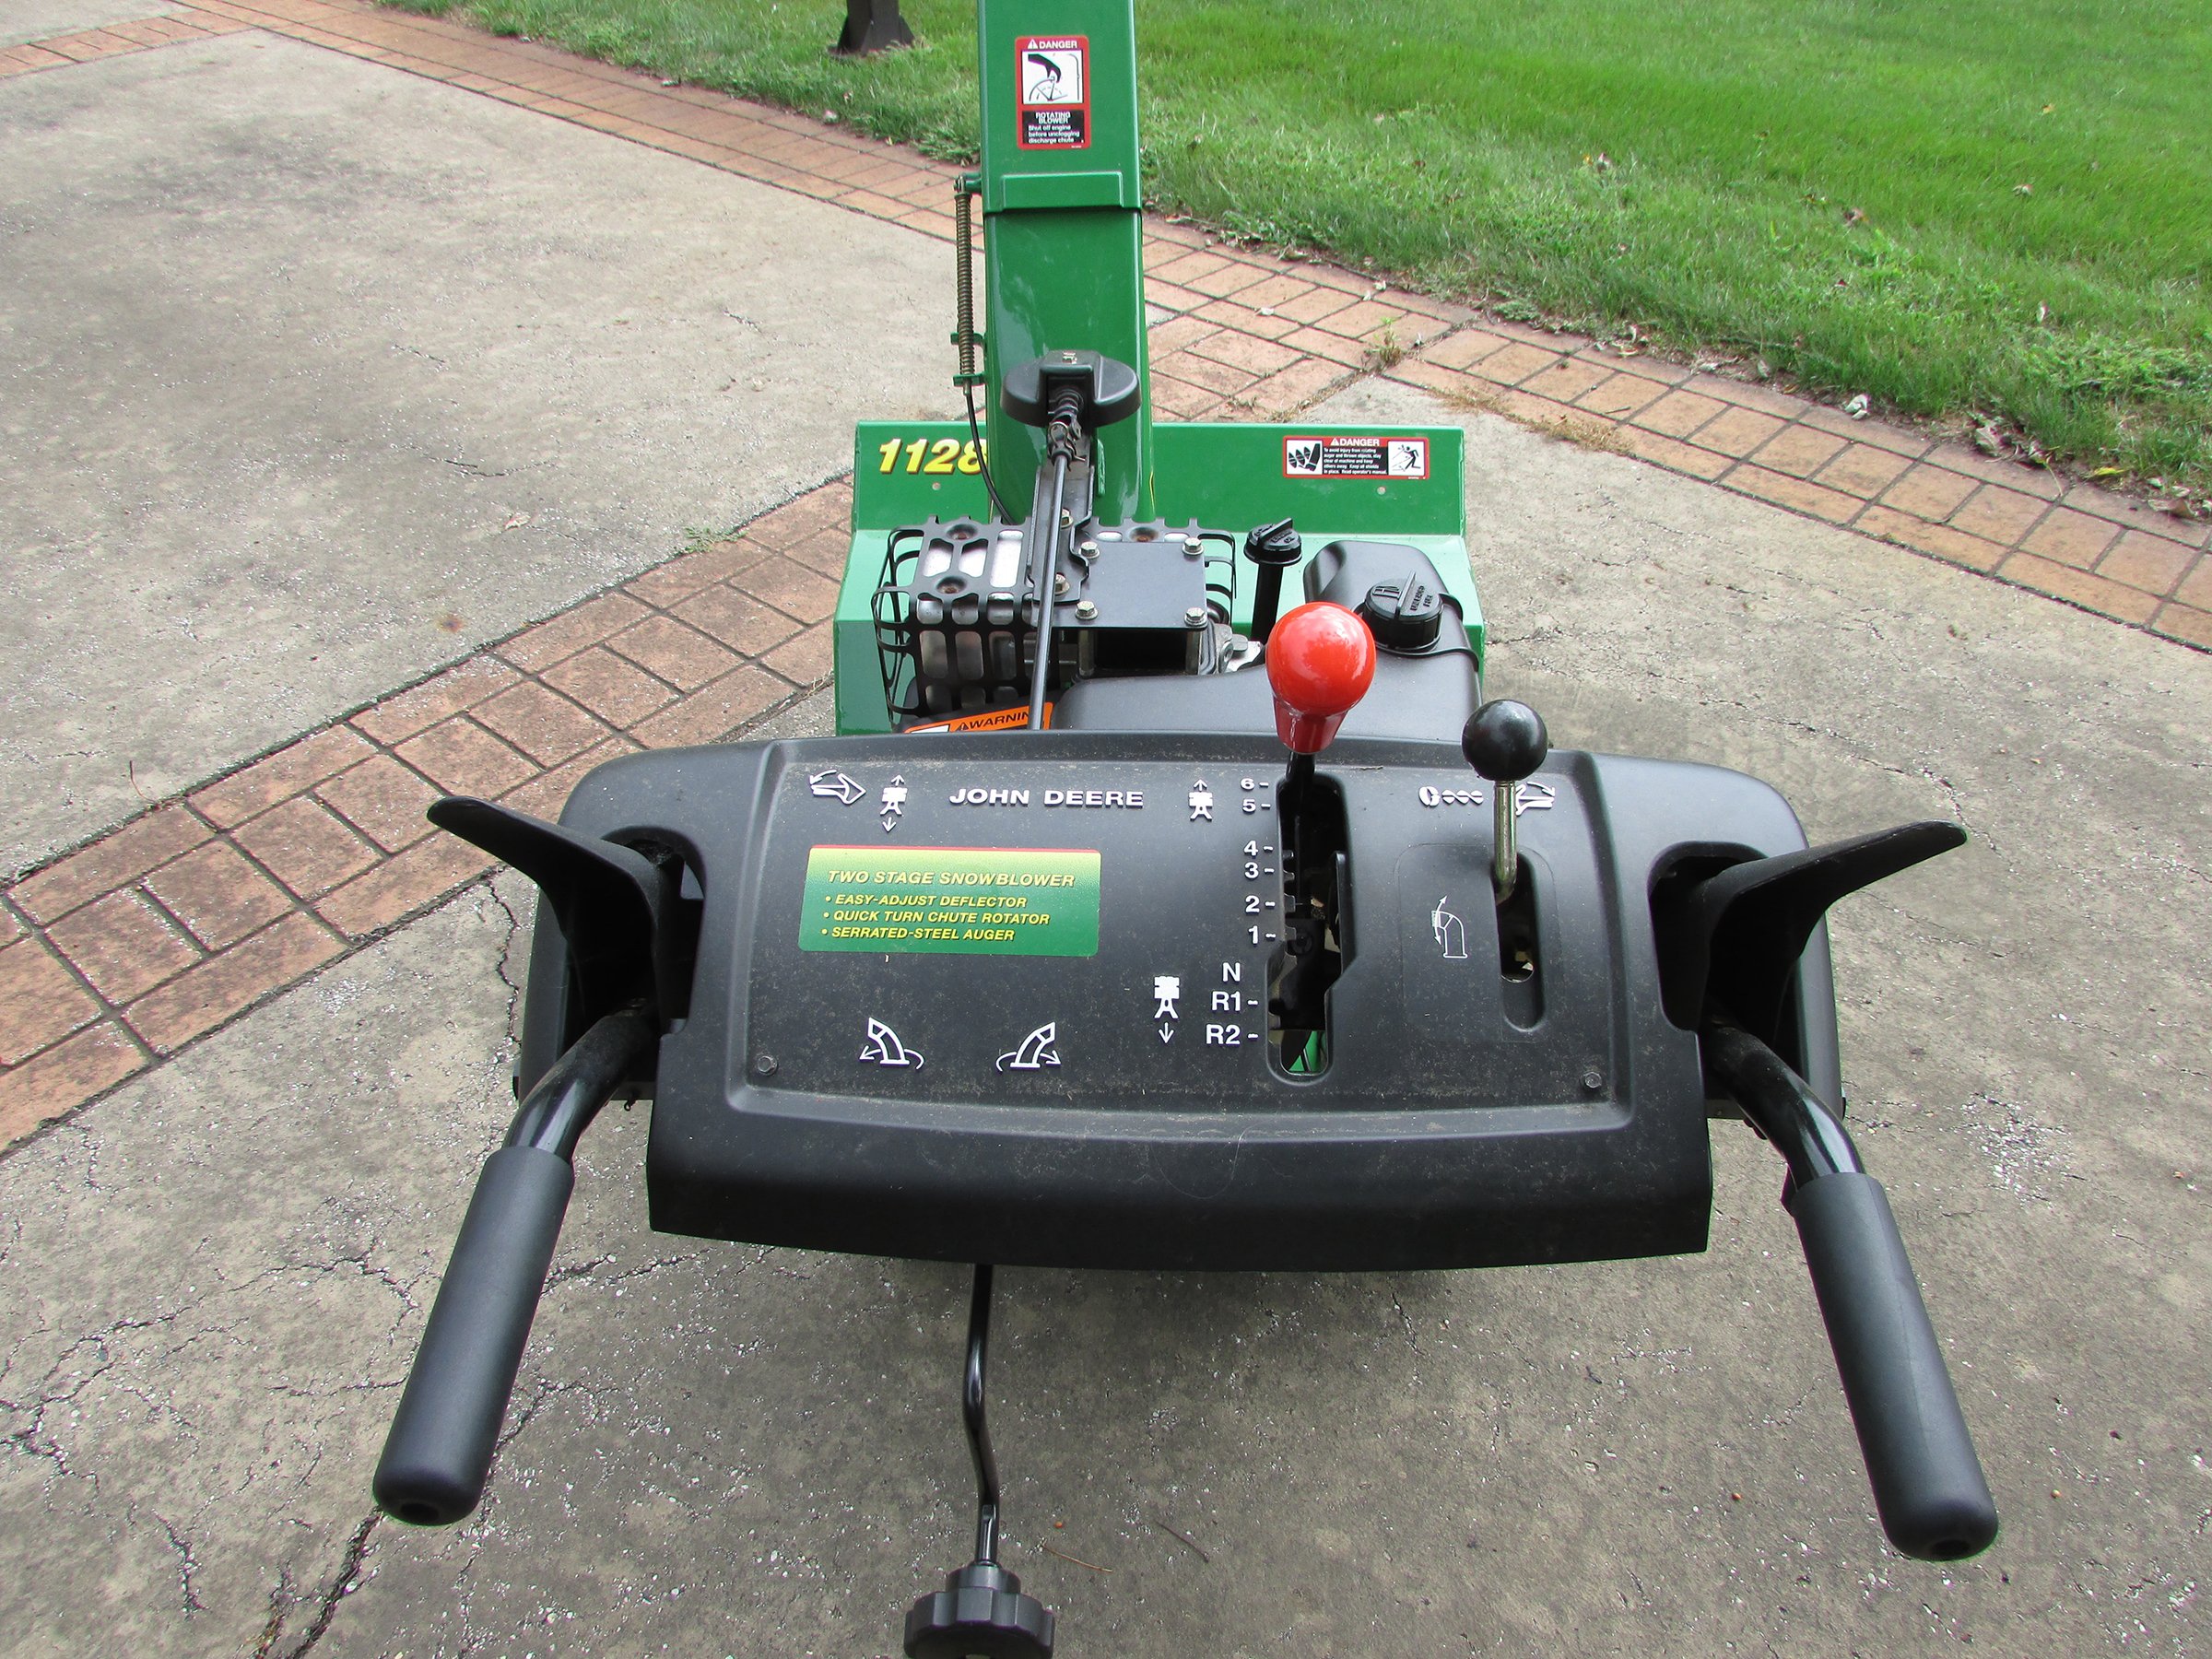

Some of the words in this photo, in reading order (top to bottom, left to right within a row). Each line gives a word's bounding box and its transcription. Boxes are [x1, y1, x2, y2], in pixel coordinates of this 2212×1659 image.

[1039, 41, 1077, 50] DANGER
[1048, 130, 1080, 138] unclogging
[1339, 438, 1380, 447] DANGER
[878, 438, 988, 475] 1128
[970, 711, 1030, 729] WARNIN
[1241, 778, 1255, 791] 6
[949, 788, 1030, 806] JOHN
[1044, 790, 1144, 808] DEERE
[1242, 799, 1257, 814] 5
[1244, 840, 1259, 858] 4
[829, 870, 869, 884] TWO
[874, 871, 935, 885] STAGE
[939, 872, 1076, 888] SNOWBLOWER
[1244, 862, 1259, 879] 3
[835, 894, 936, 907] EASY-ADJUST
[940, 895, 1028, 908] DEFLECTOR
[1245, 895, 1260, 913] 2
[833, 910, 880, 923] QUICK
[884, 911, 924, 923] TURN
[927, 912, 978, 924] CHUTE
[982, 912, 1051, 925] ROTATOR
[831, 926, 959, 940] SERRATED-STEEL
[963, 928, 1016, 941] AUGER
[1248, 925, 1259, 945] 1
[1222, 962, 1241, 982] N
[1211, 991, 1241, 1012] R1
[1206, 1024, 1241, 1045] R2
